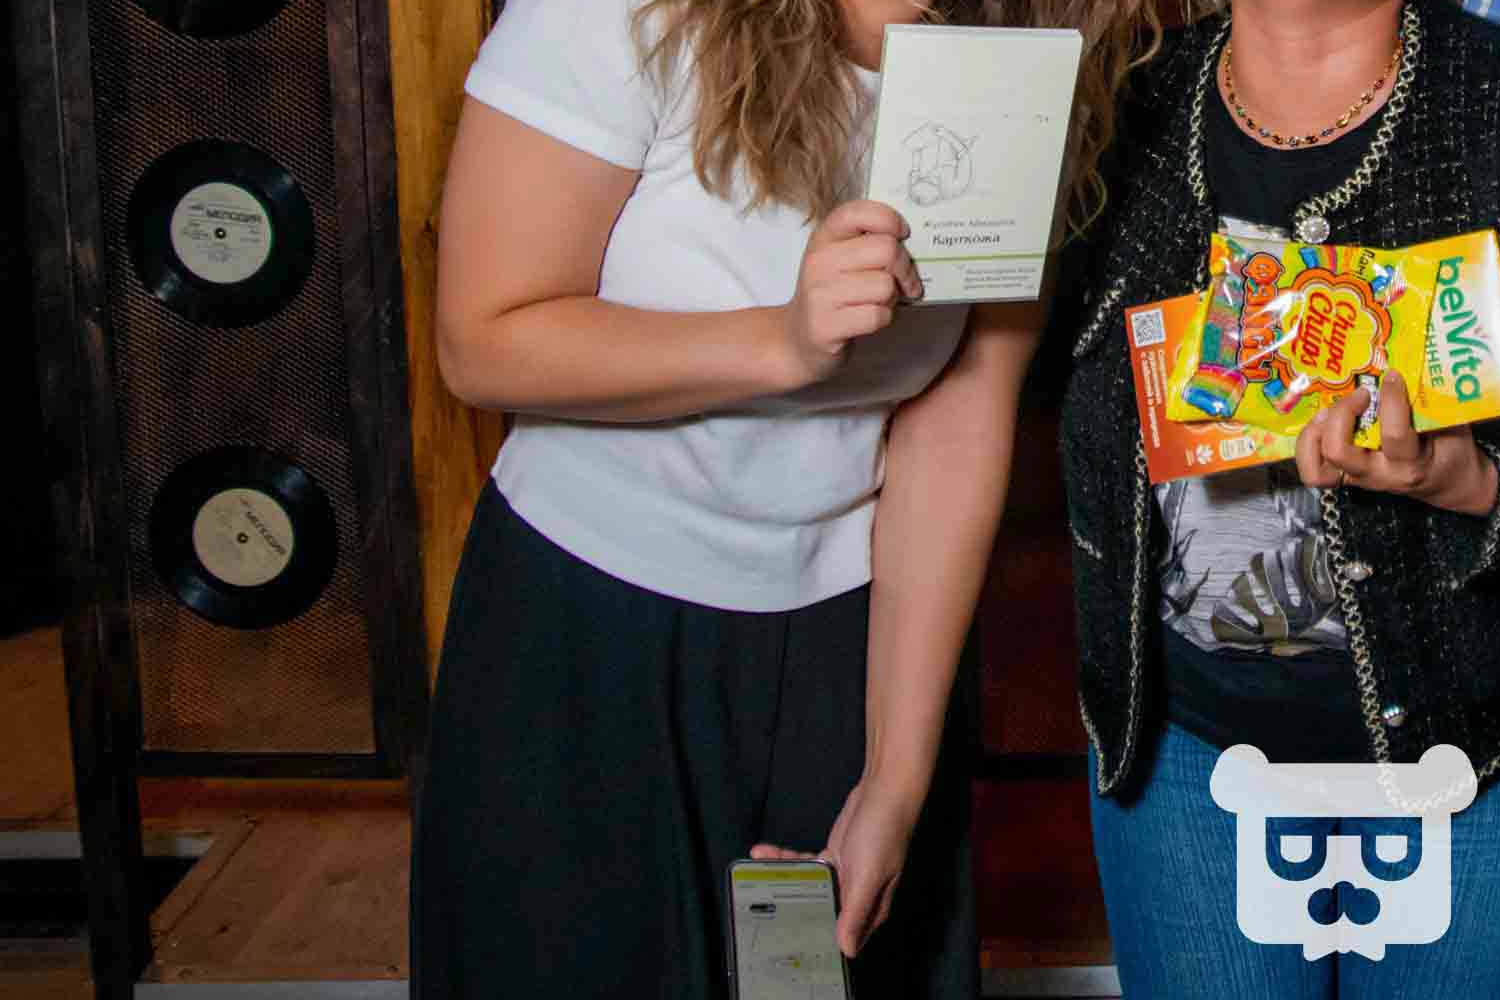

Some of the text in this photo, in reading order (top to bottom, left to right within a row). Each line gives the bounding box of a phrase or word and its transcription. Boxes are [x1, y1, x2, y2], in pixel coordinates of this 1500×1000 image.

[1299, 290, 1334, 369] Chups
[1325, 299, 1358, 377] Chupa
[1437, 255, 1490, 403] belVita
